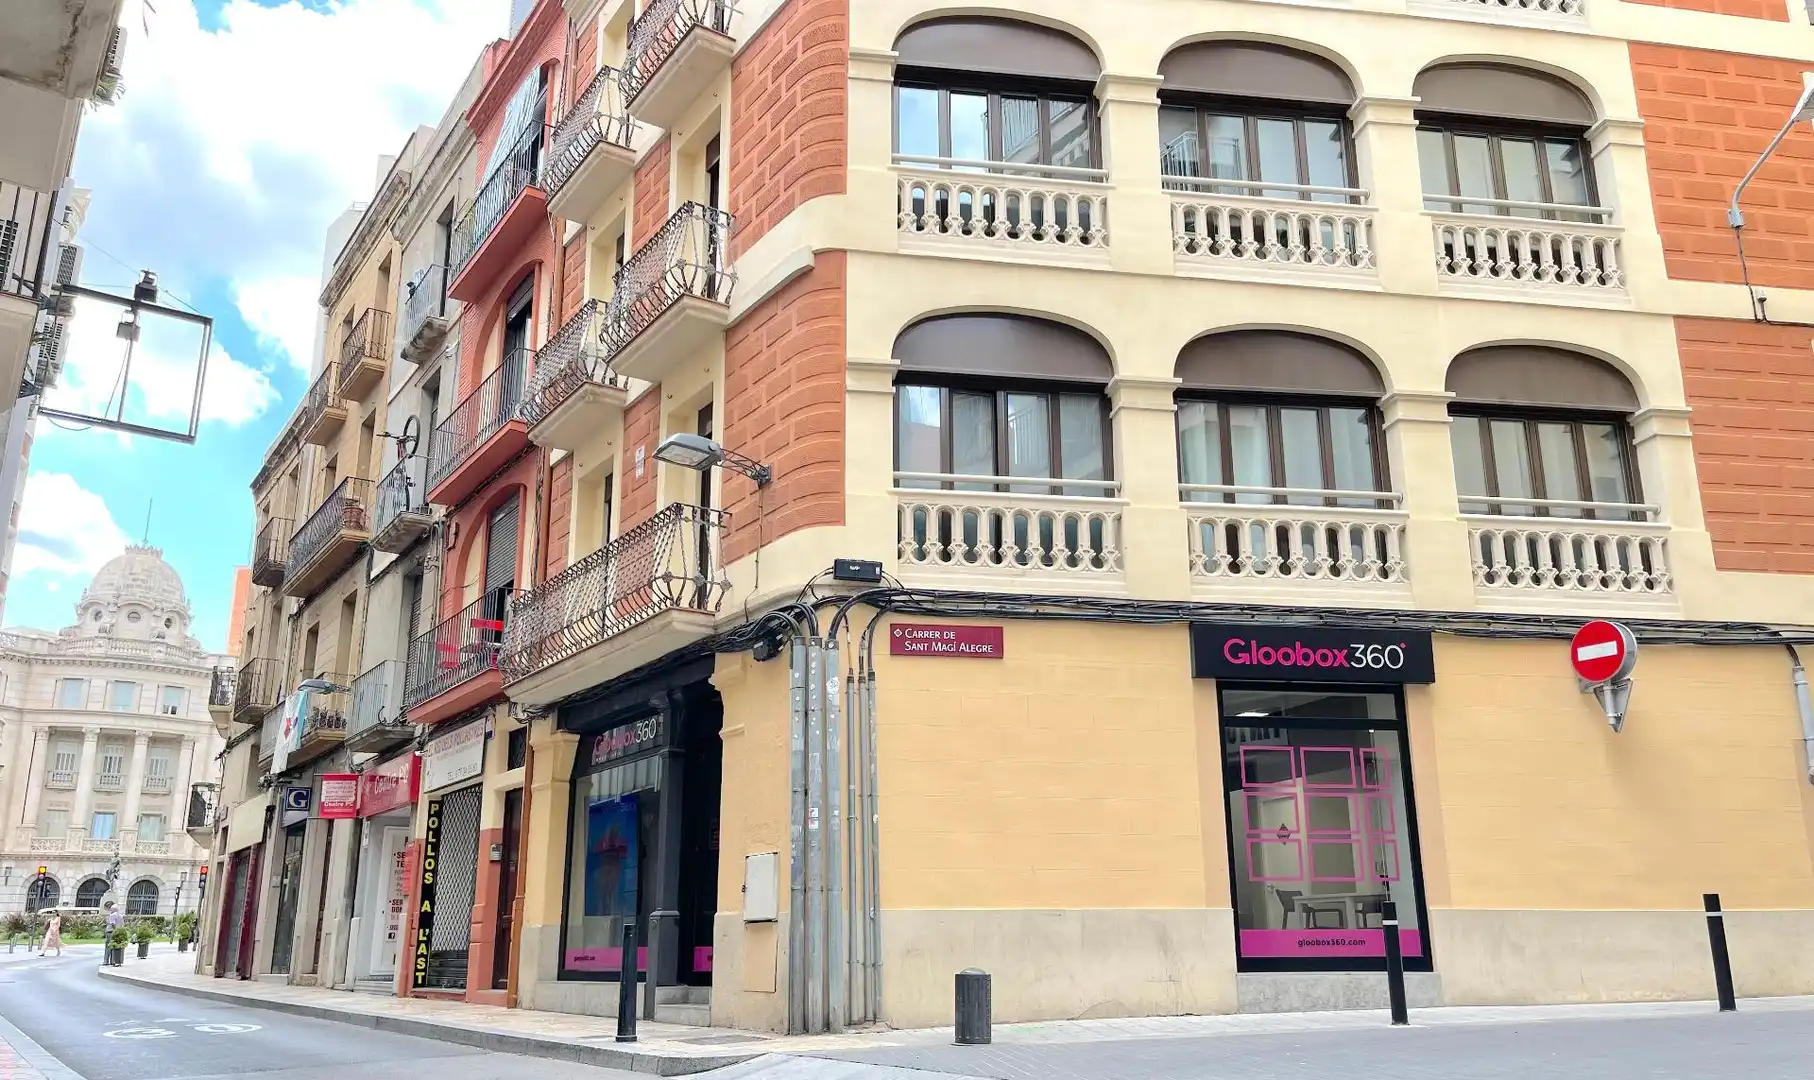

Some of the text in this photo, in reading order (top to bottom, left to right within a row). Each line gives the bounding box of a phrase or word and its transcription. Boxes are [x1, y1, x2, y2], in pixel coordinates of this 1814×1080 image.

[904, 628, 956, 640] CARRER DE
[904, 641, 994, 653] SANT MAGÍ ALEGRE
[288, 790, 308, 808] G
[415, 803, 440, 984] POLLOS A L'AST
[1297, 938, 1366, 948] gloobox360.com
